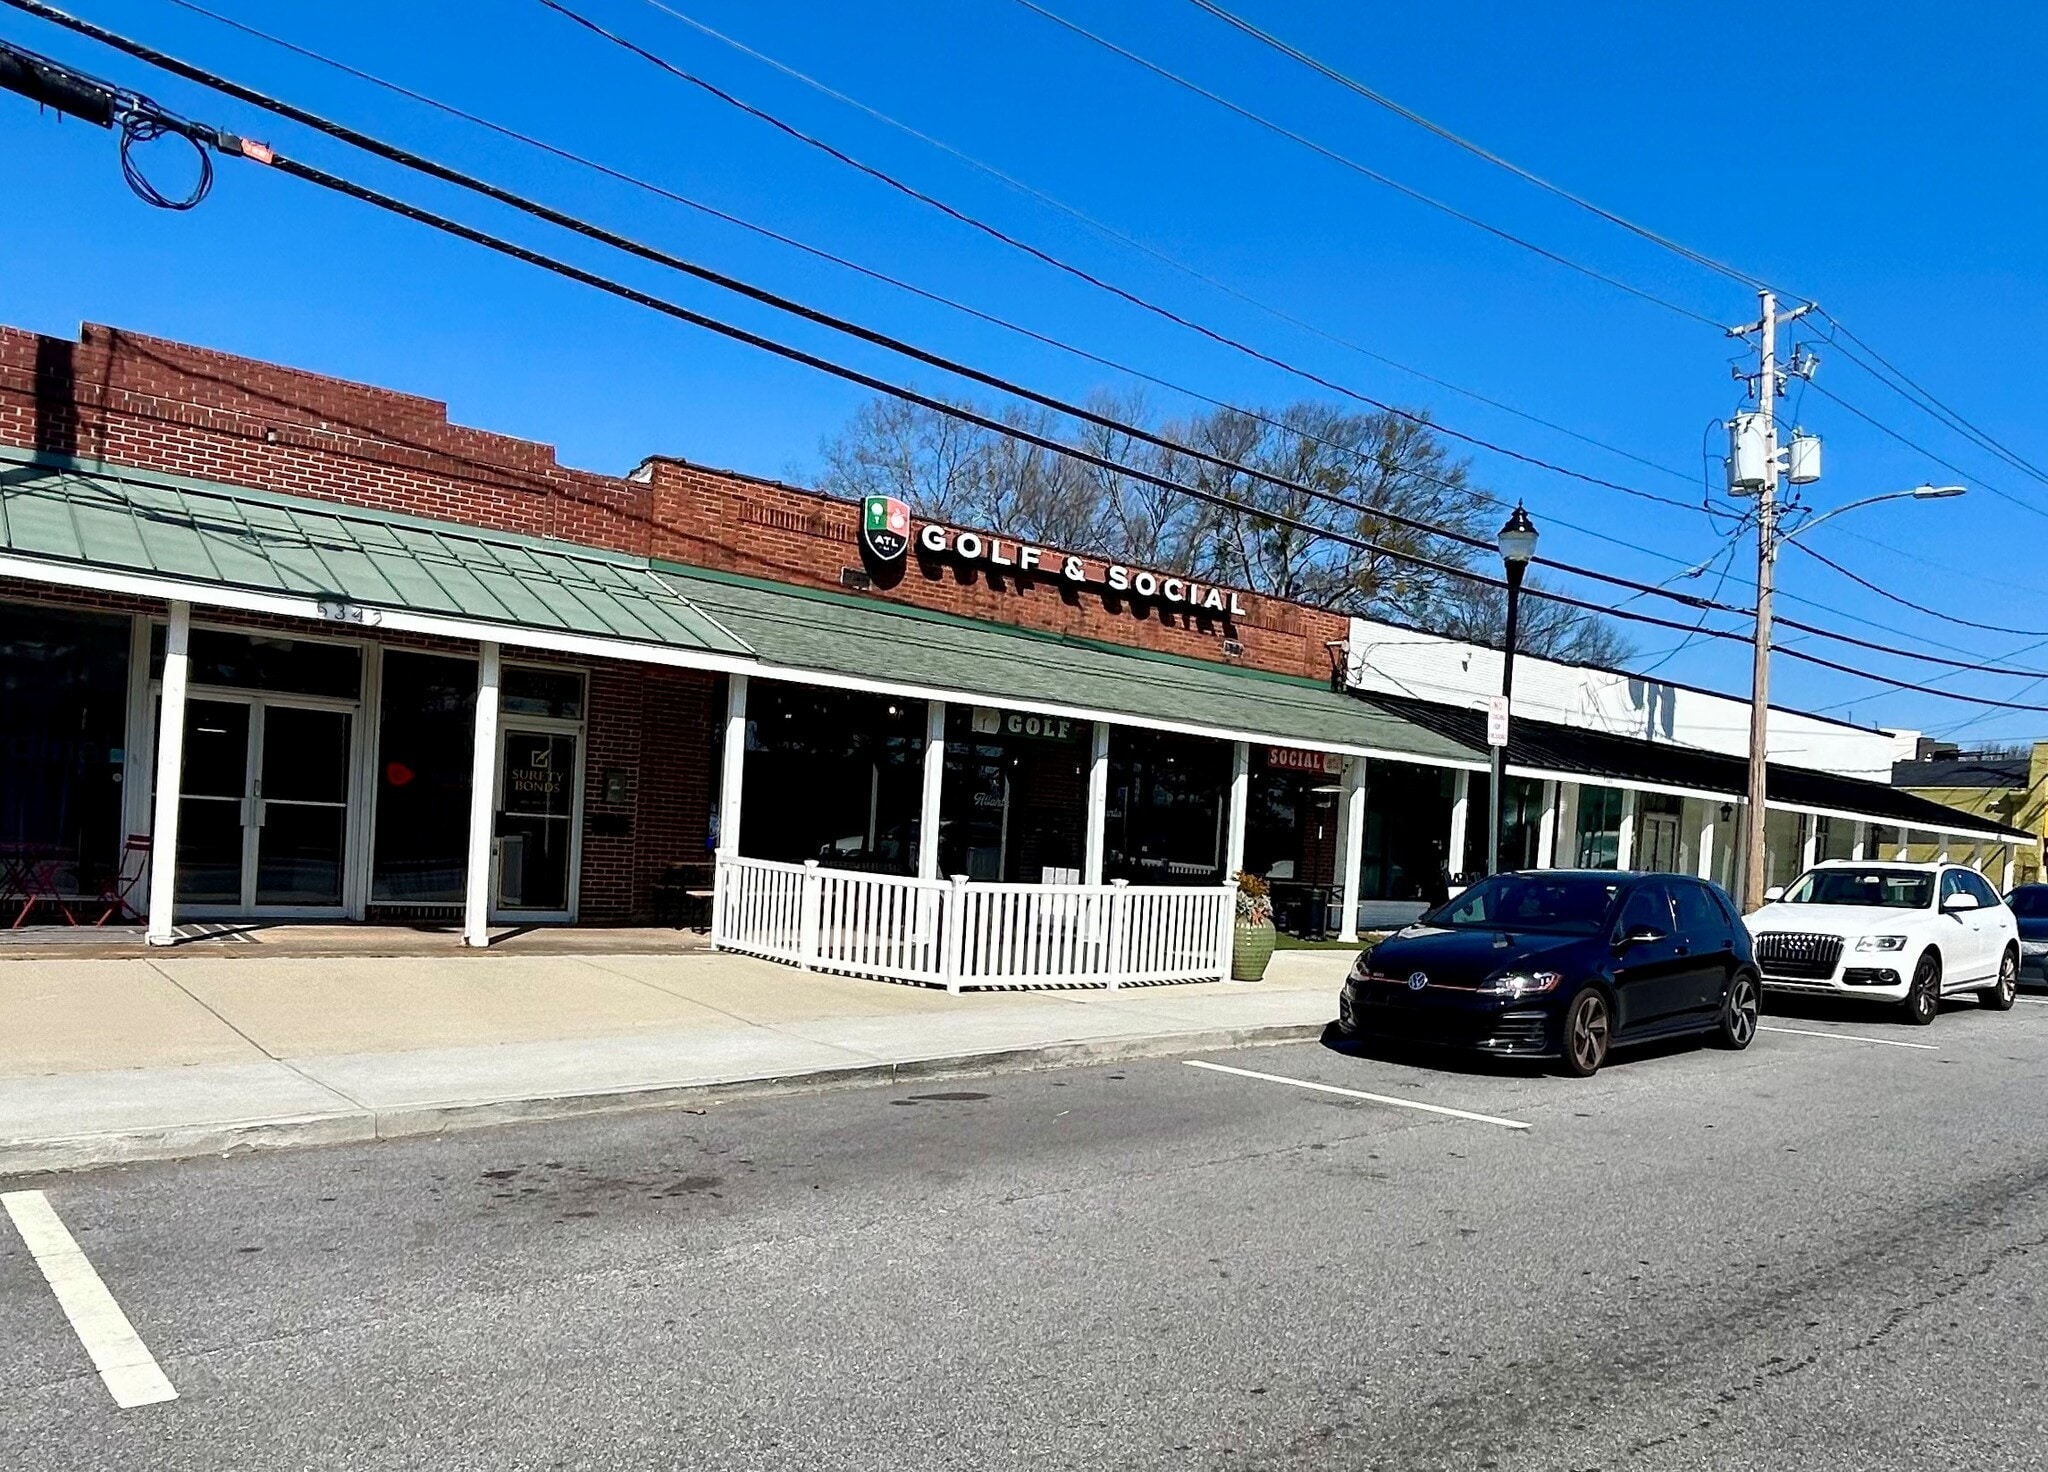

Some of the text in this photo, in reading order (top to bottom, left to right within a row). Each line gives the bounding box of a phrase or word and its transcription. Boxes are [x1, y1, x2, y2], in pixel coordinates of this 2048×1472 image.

[874, 535, 899, 548] ATL
[921, 525, 1246, 616] GOLF & SOCIAL
[1007, 715, 1071, 738] GOLF
[1270, 748, 1321, 769] SOCIAL
[512, 768, 564, 782] SURETY
[515, 780, 561, 793] BONDS
